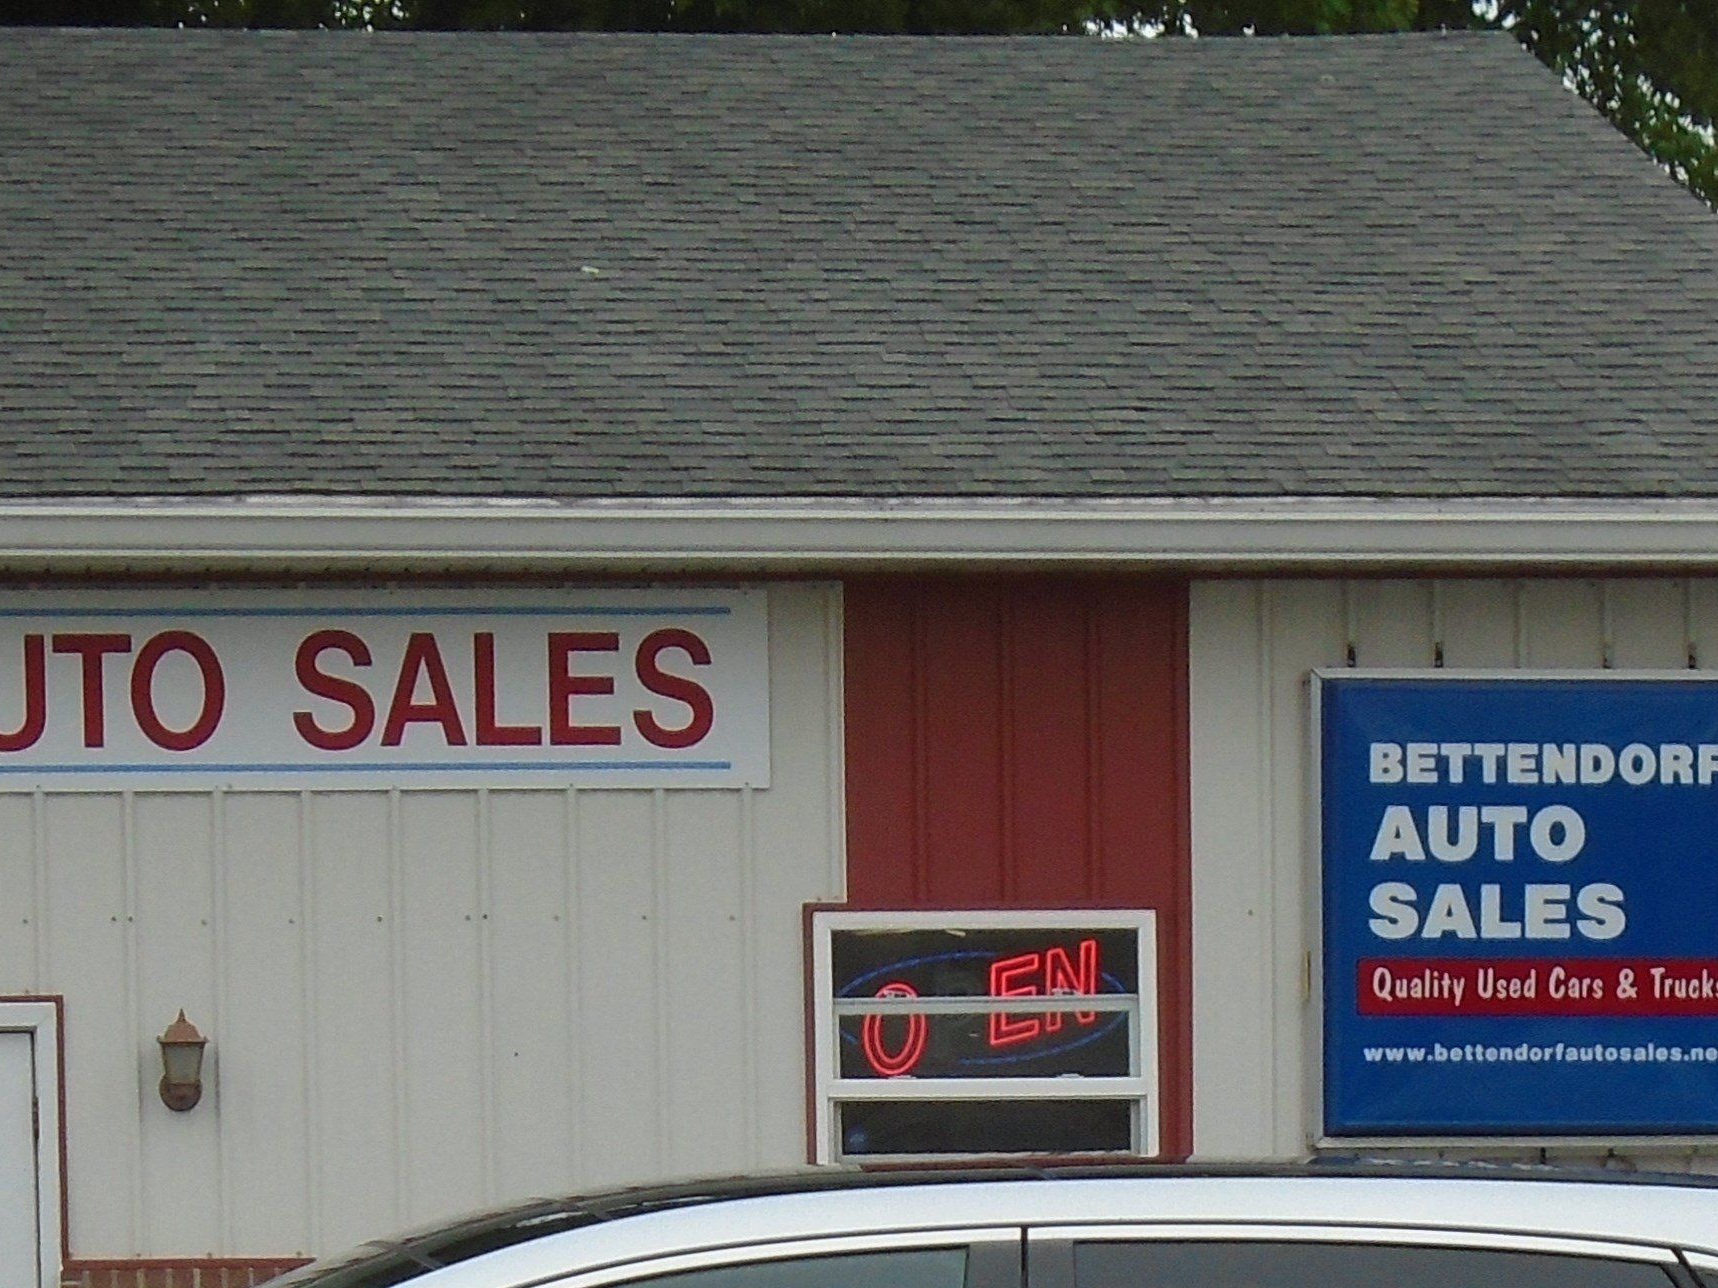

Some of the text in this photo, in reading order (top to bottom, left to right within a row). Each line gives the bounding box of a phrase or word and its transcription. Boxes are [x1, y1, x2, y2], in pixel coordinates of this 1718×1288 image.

[296, 631, 713, 751] SALES
[1370, 806, 1585, 861] AUTO
[1369, 883, 1625, 939] SALES
[862, 938, 1100, 1077] OEN
[1373, 968, 1464, 1005] Quality
[1478, 968, 1535, 998] Used
[1549, 967, 1602, 998] Cars
[1617, 969, 1637, 998] &
